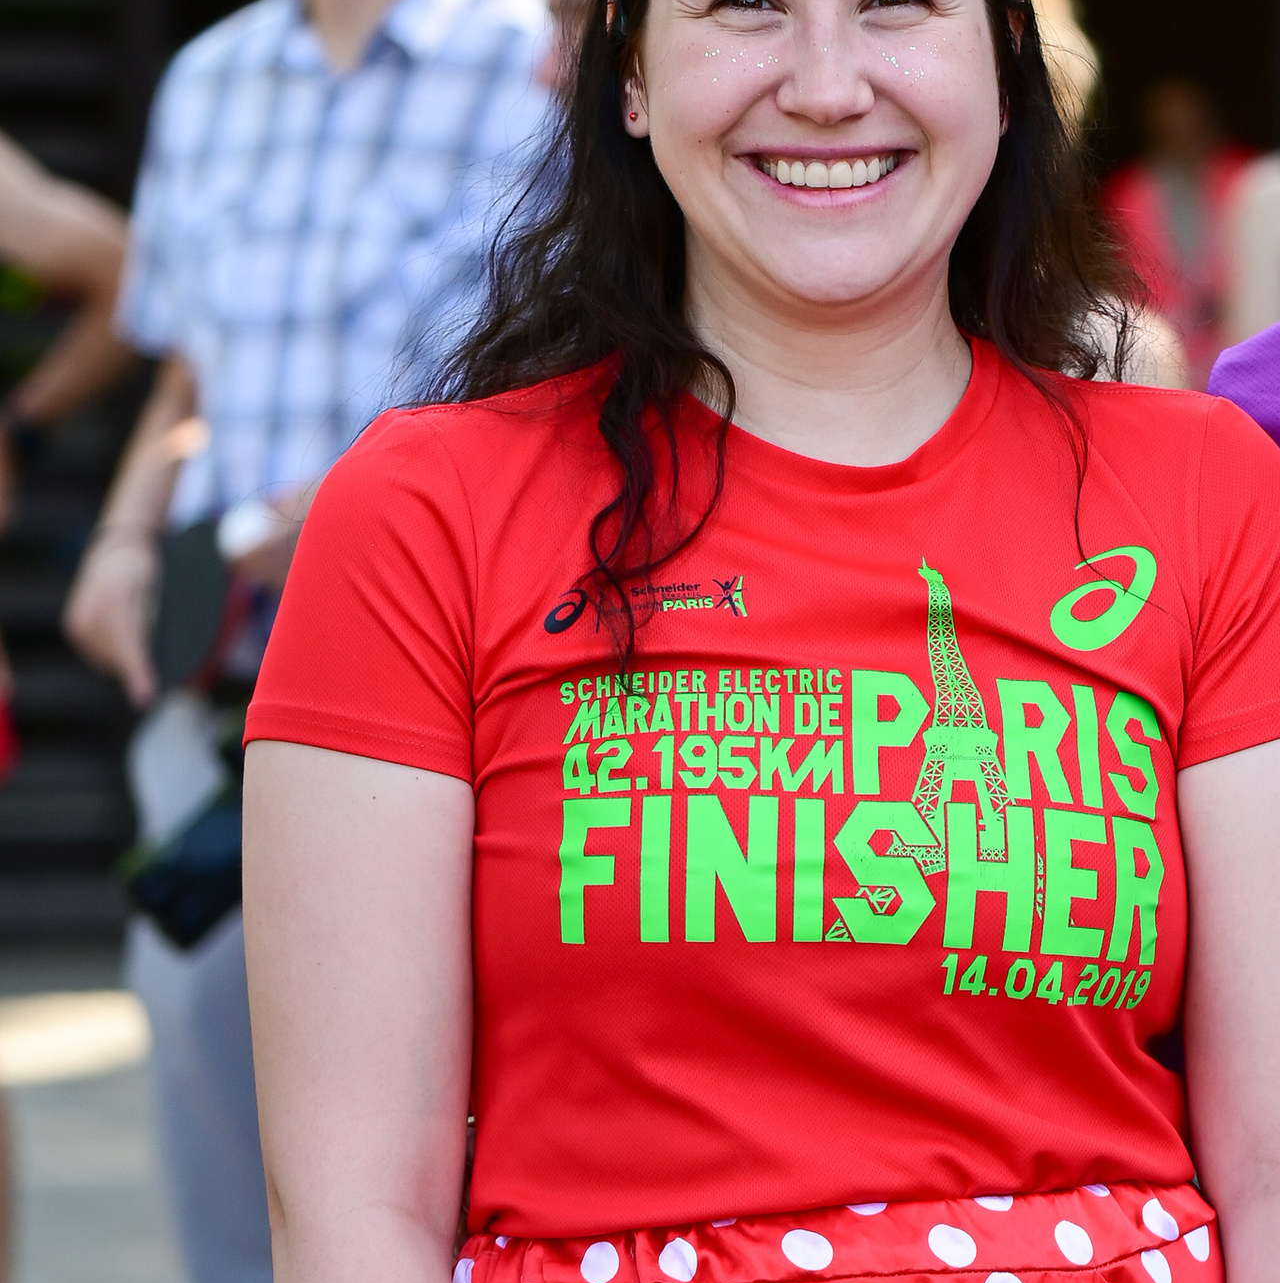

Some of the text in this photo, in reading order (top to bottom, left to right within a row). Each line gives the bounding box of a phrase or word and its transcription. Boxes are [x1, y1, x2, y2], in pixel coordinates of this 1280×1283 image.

[664, 597, 714, 611] PARIS
[560, 669, 843, 704] SCHNEIDER ELECTRIC
[563, 693, 843, 744] MARATHON DE
[851, 666, 1161, 821] PARIS
[562, 735, 844, 795] 42.195KM
[559, 794, 1164, 965] FINISHER
[941, 953, 1151, 1009] 14.04.2019
